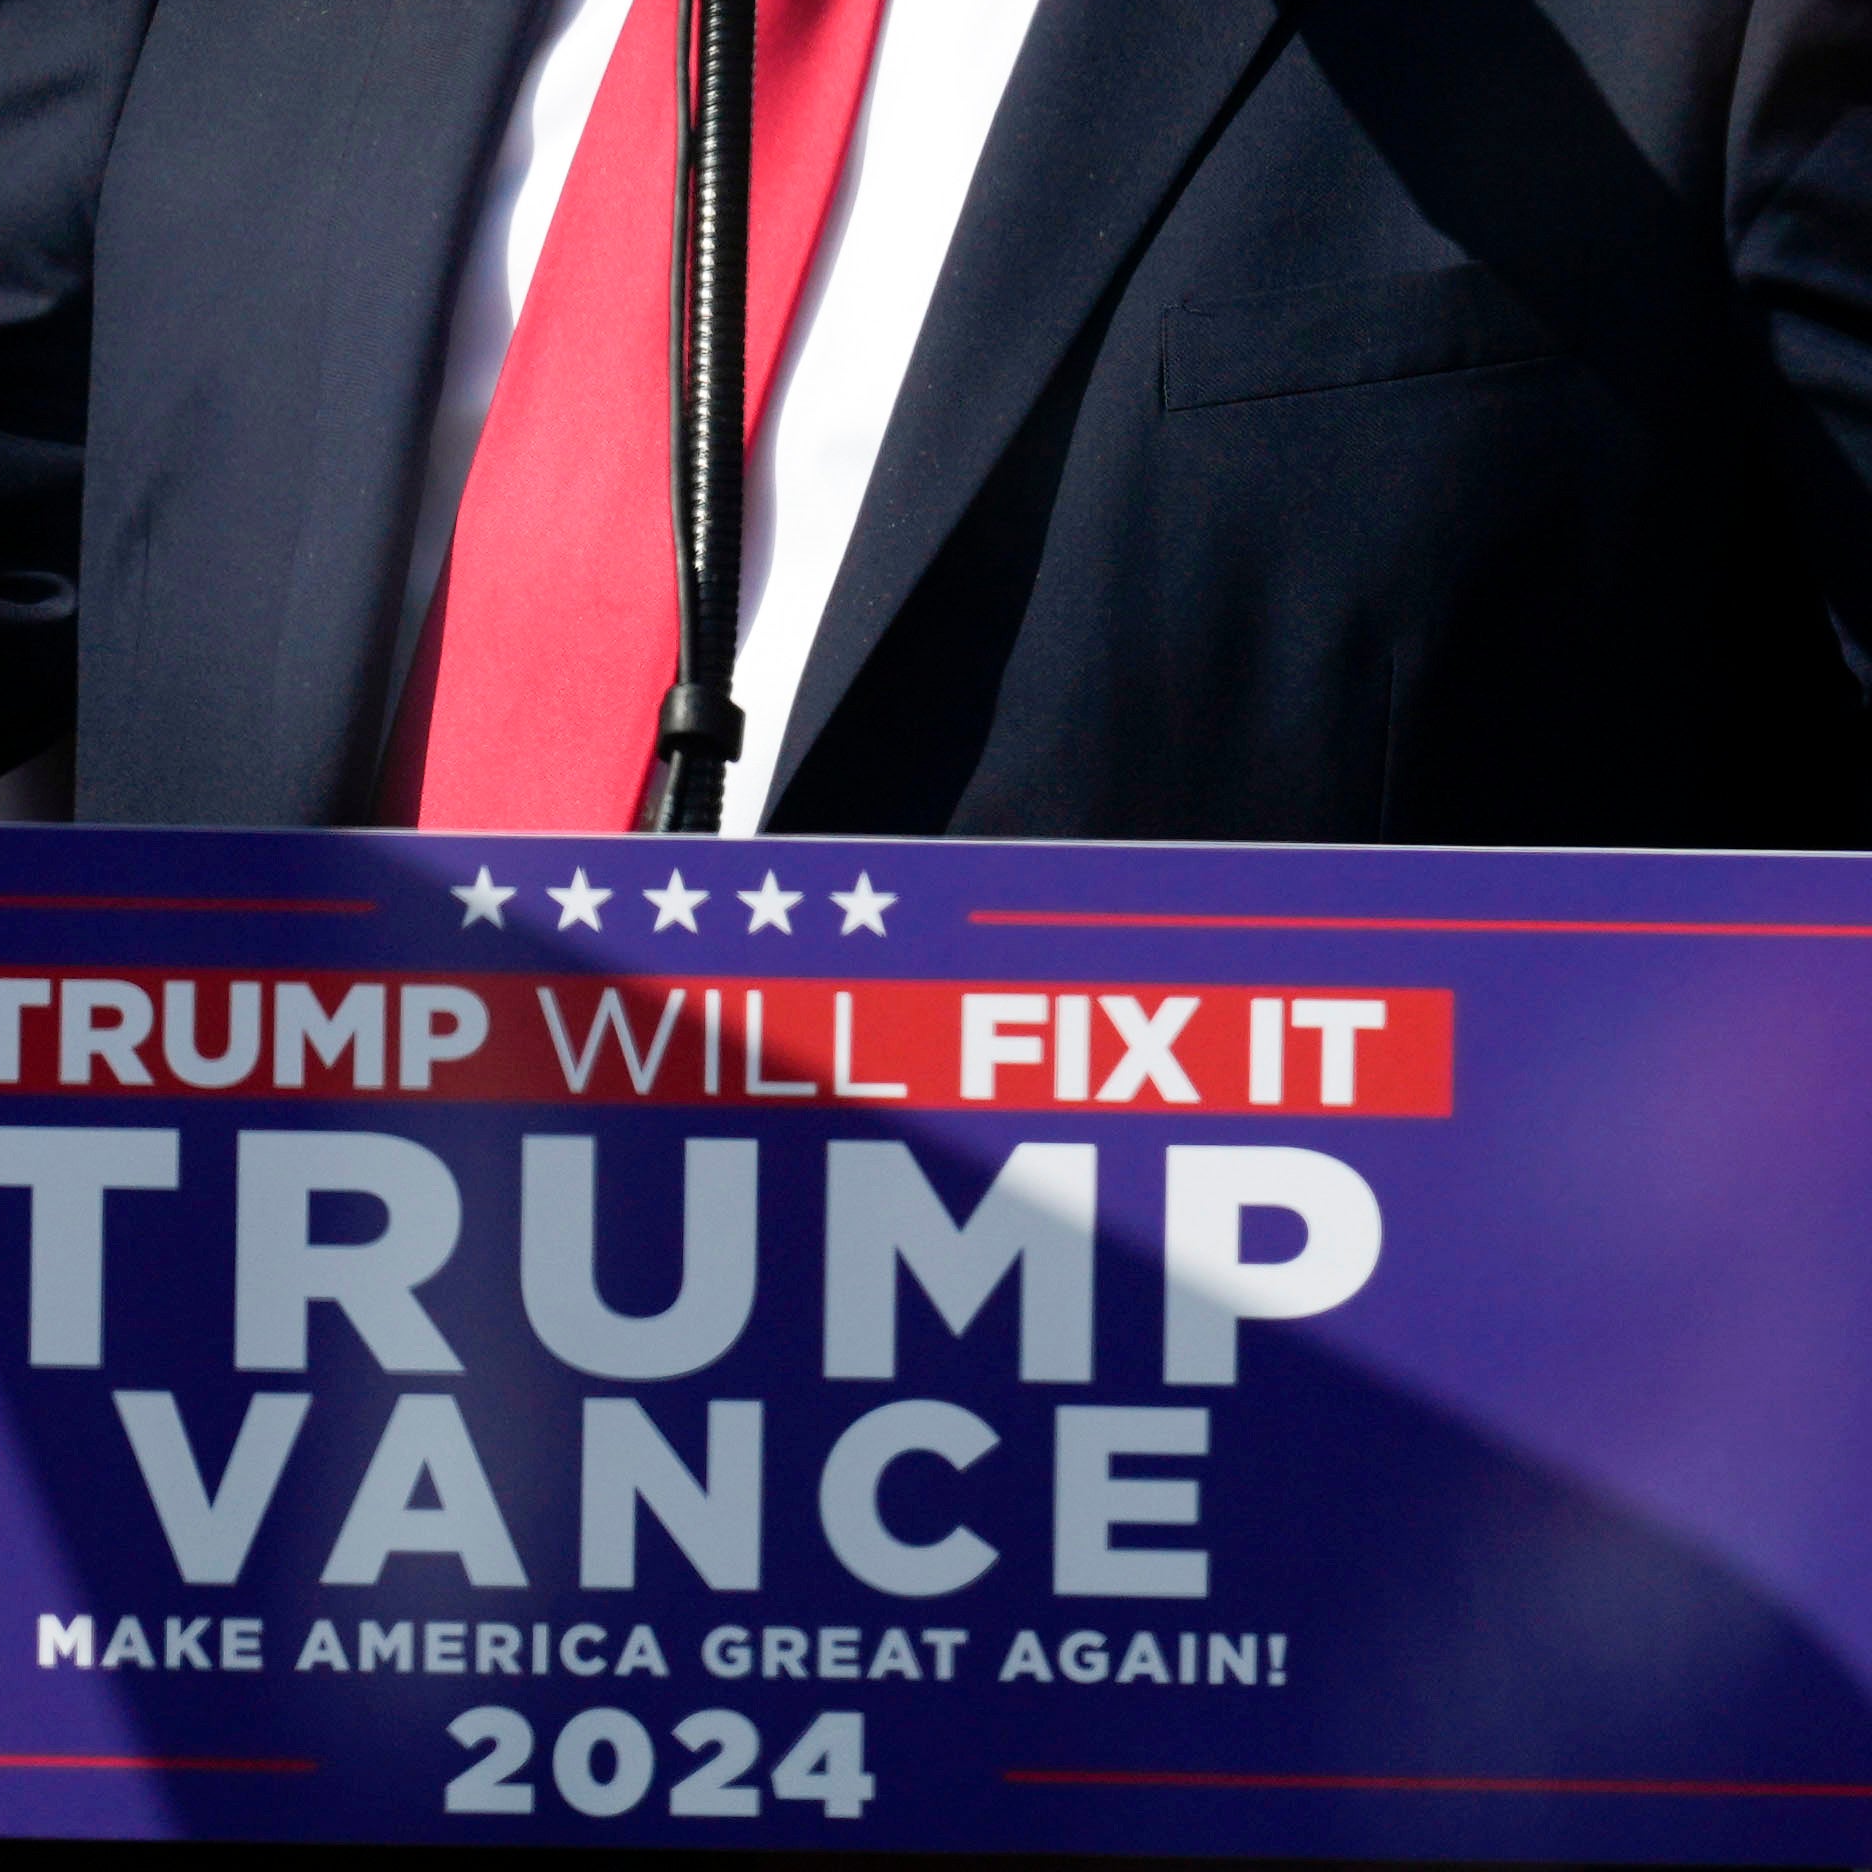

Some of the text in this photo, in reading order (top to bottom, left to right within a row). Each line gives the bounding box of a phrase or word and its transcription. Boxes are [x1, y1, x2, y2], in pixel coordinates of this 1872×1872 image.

[538, 988, 908, 1098] WILL
[960, 993, 1202, 1104] FIX
[1248, 996, 1387, 1107] IT
[114, 1391, 1209, 1597] VANCE
[37, 1614, 1285, 1685] MAKE AMERICA GREAT AGAIN!
[445, 1706, 874, 1818] 2024
